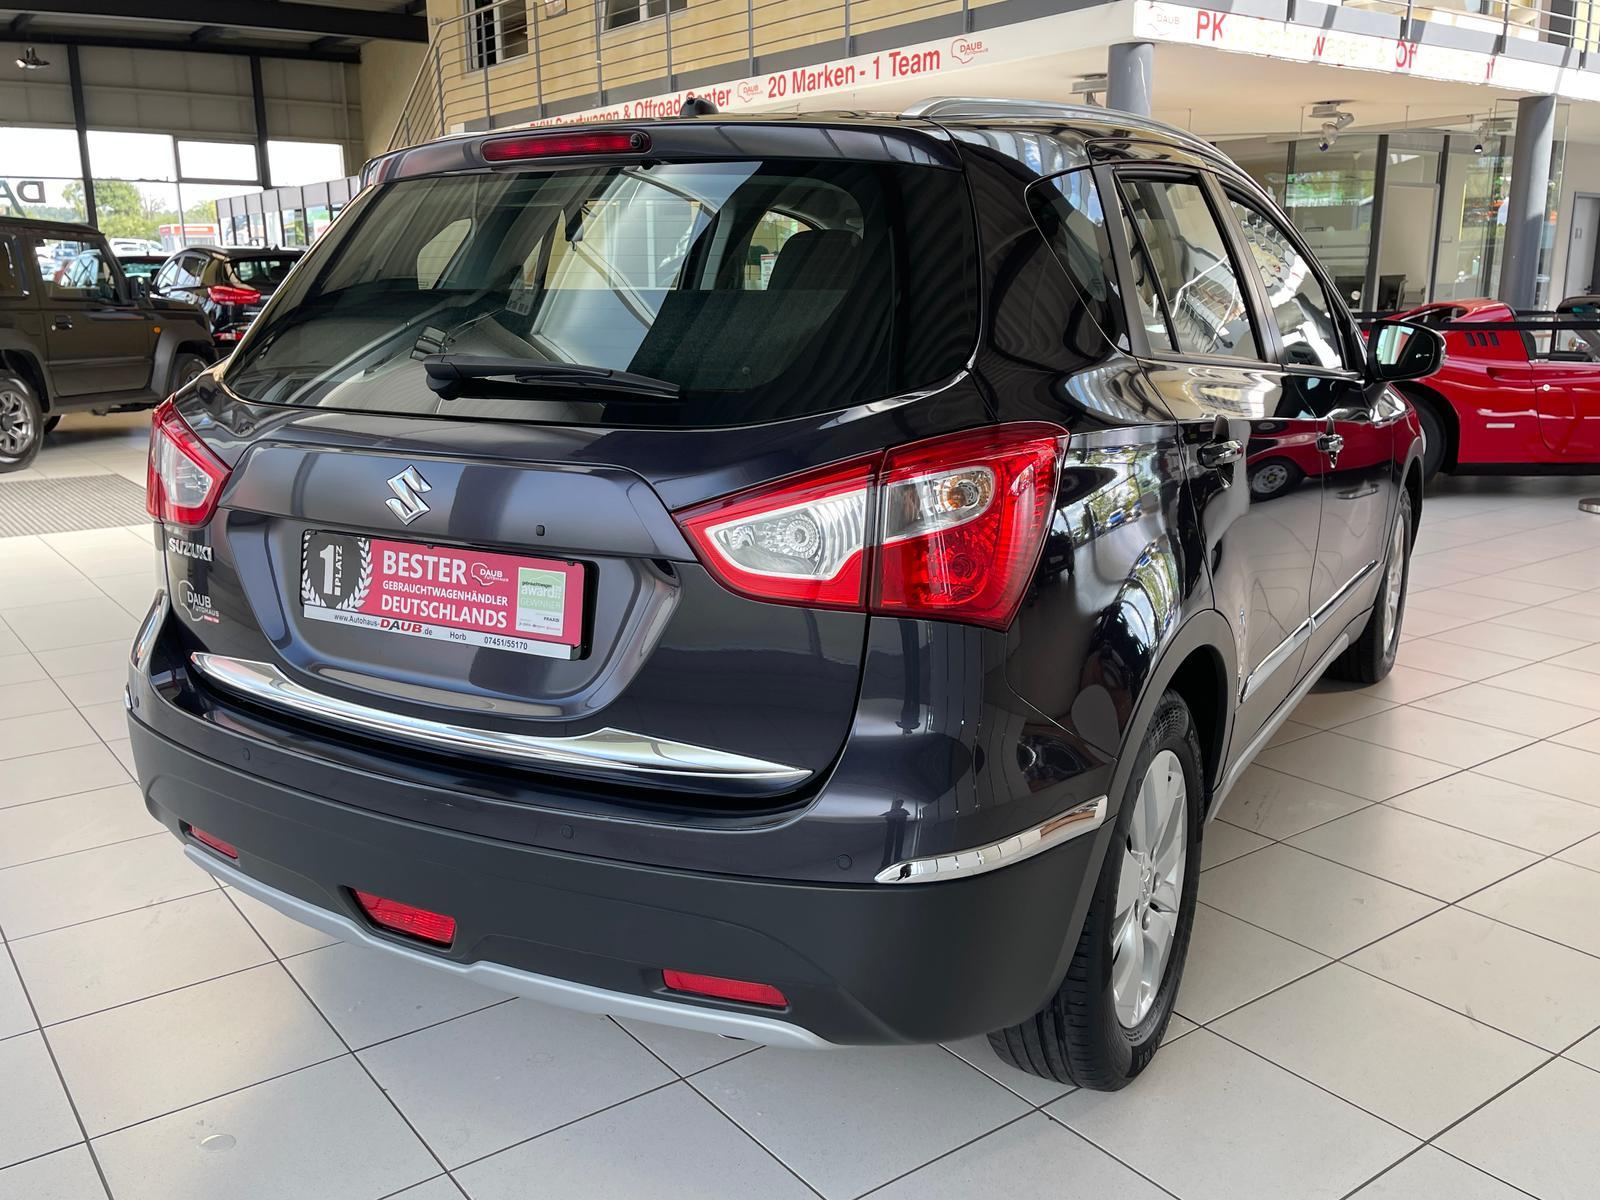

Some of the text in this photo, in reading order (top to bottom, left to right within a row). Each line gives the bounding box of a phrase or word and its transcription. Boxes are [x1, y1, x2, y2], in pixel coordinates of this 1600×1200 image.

[960, 41, 983, 53] DAUB
[768, 74, 787, 98] 20
[792, 61, 855, 94] Marken
[872, 56, 880, 80] 1
[889, 49, 941, 77] Team
[624, 104, 631, 119] &
[635, 94, 681, 119] Offroad
[686, 87, 731, 107] nter
[168, 537, 214, 562] SUZUKI
[335, 545, 343, 587] PLATZ
[382, 550, 468, 585] BESTER
[480, 568, 503, 578] DAUB
[187, 590, 212, 609] DAUB
[382, 580, 509, 606] GEBRAUCHTWAGENHÄNDLER
[381, 594, 508, 629] DEUTSCHLANDS
[449, 631, 467, 641] Horb
[484, 635, 529, 650] 07451/55170
